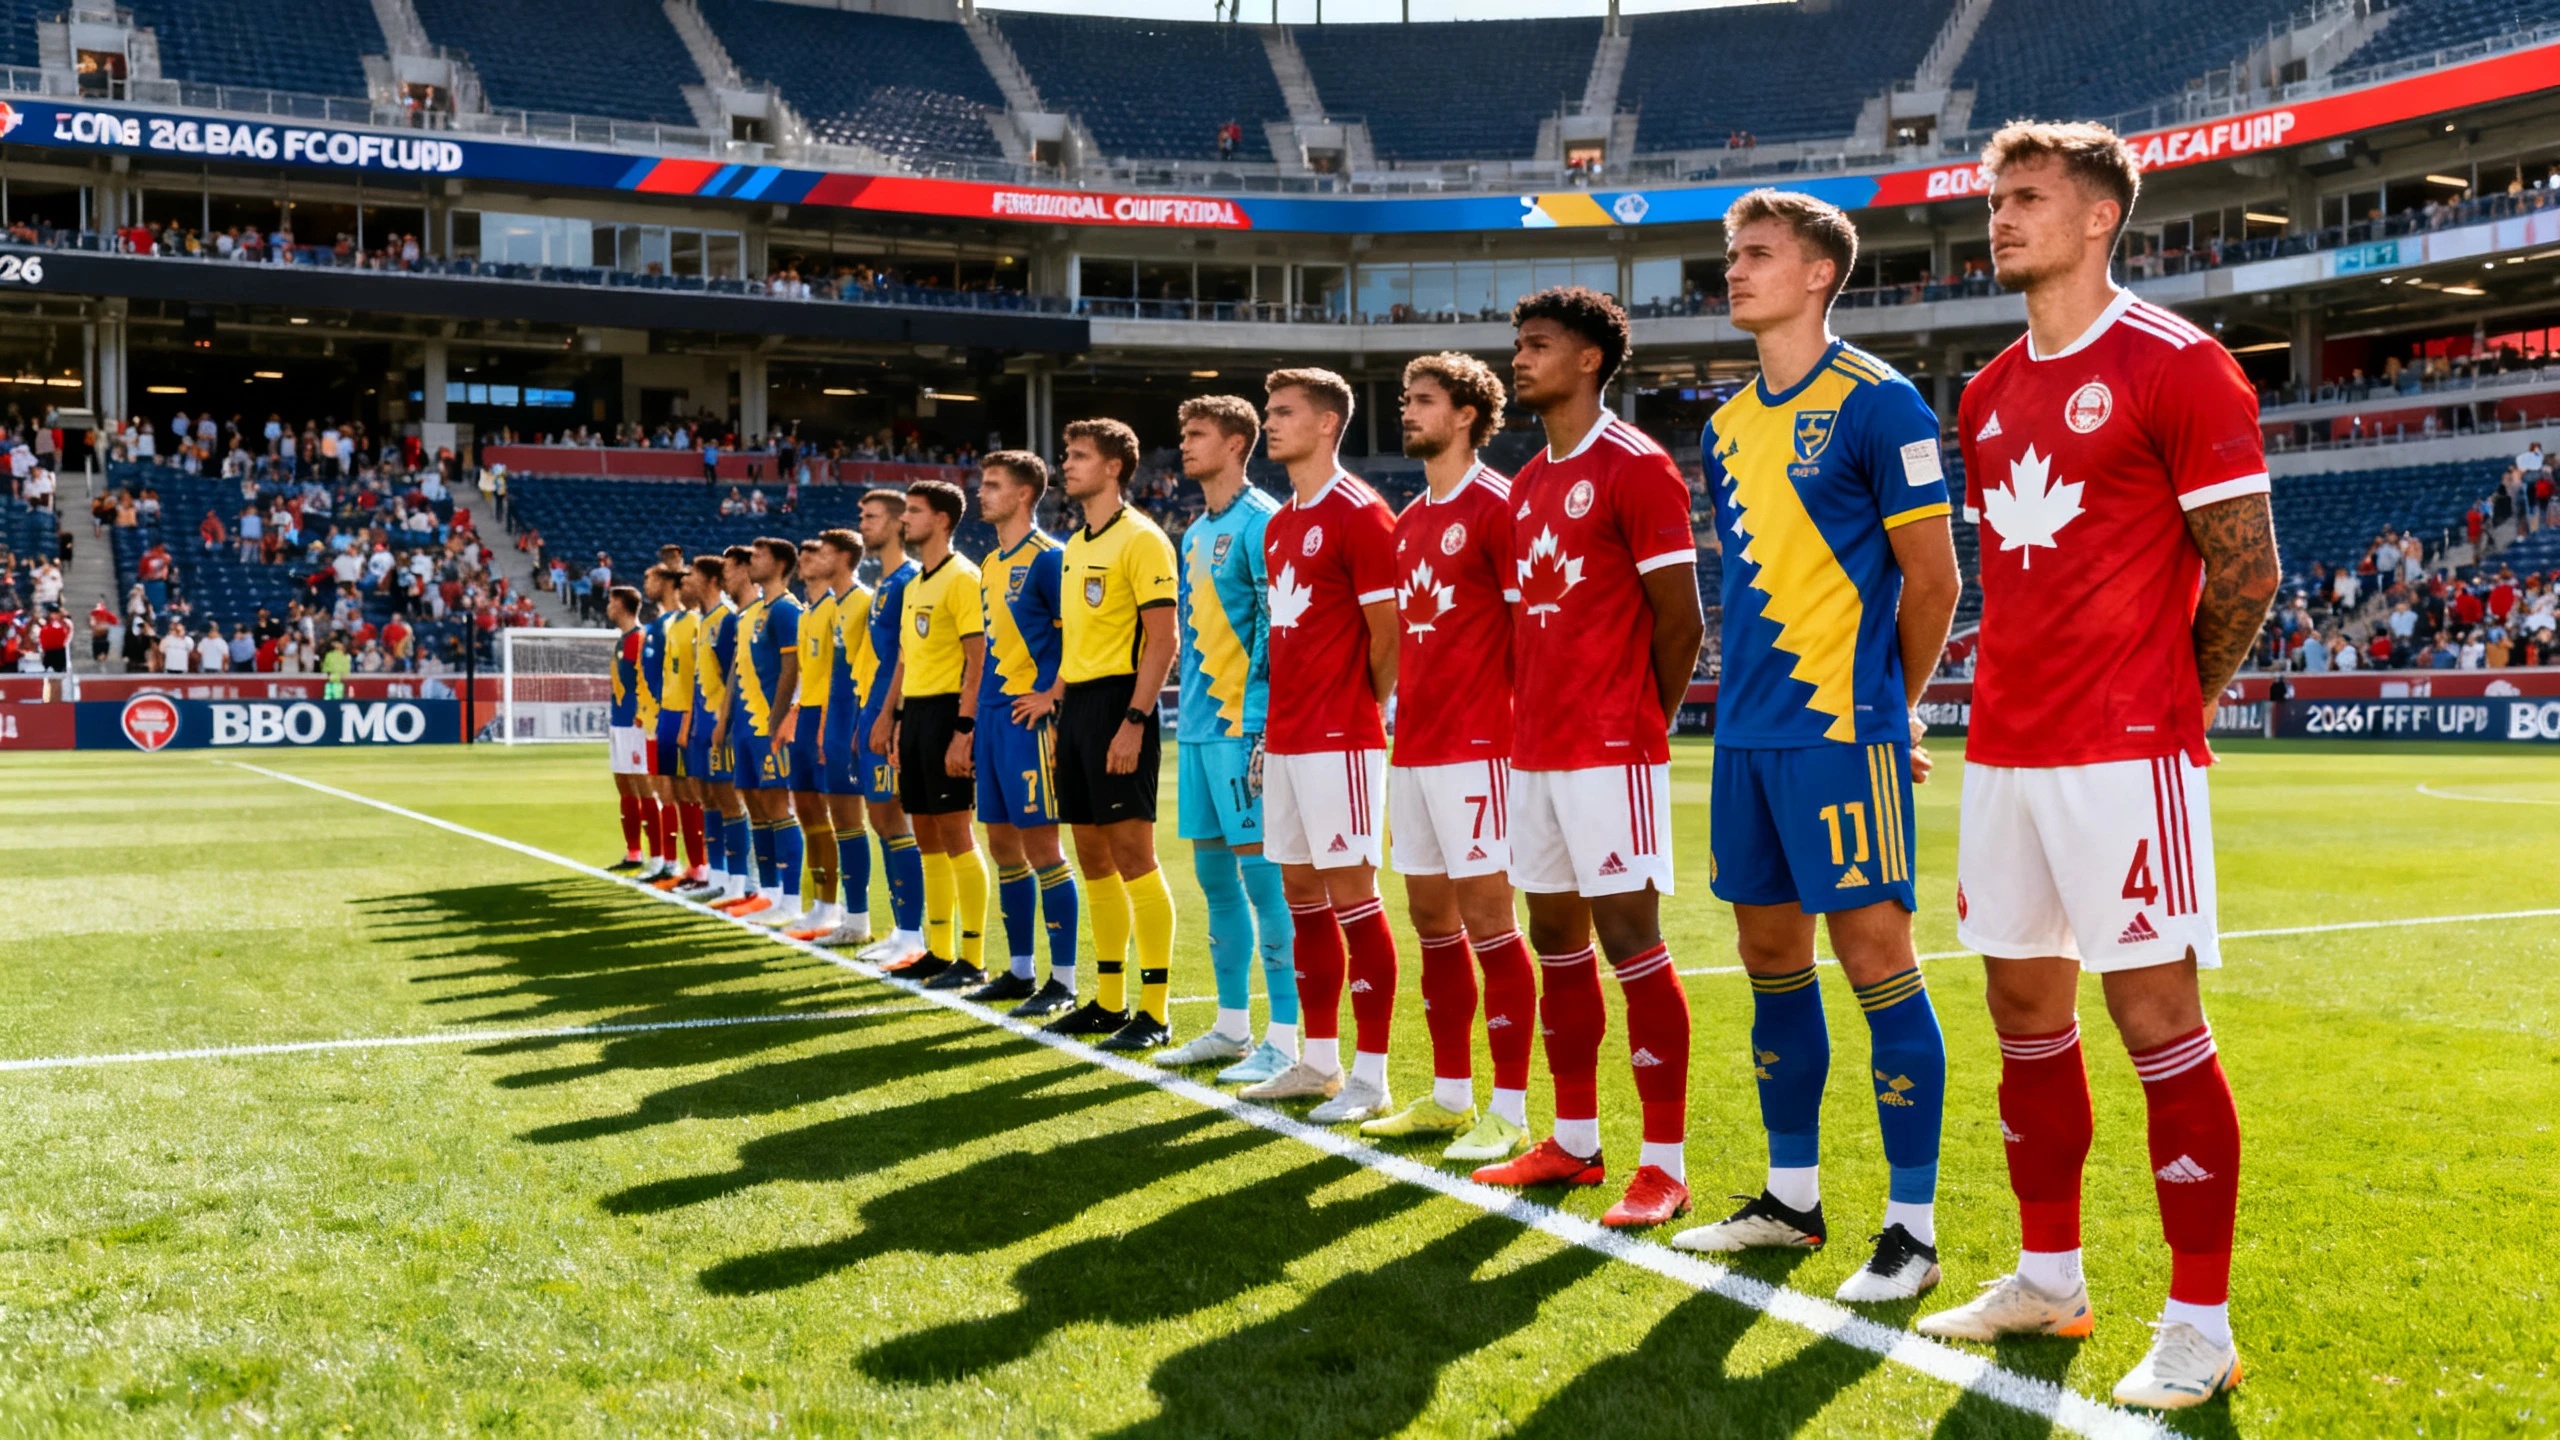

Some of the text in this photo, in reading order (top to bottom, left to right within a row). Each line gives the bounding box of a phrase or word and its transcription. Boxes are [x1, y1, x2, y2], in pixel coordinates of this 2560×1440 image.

[209, 702, 426, 744] BBO MO
[1465, 795, 1488, 840] 7
[2121, 838, 2159, 906] 4
